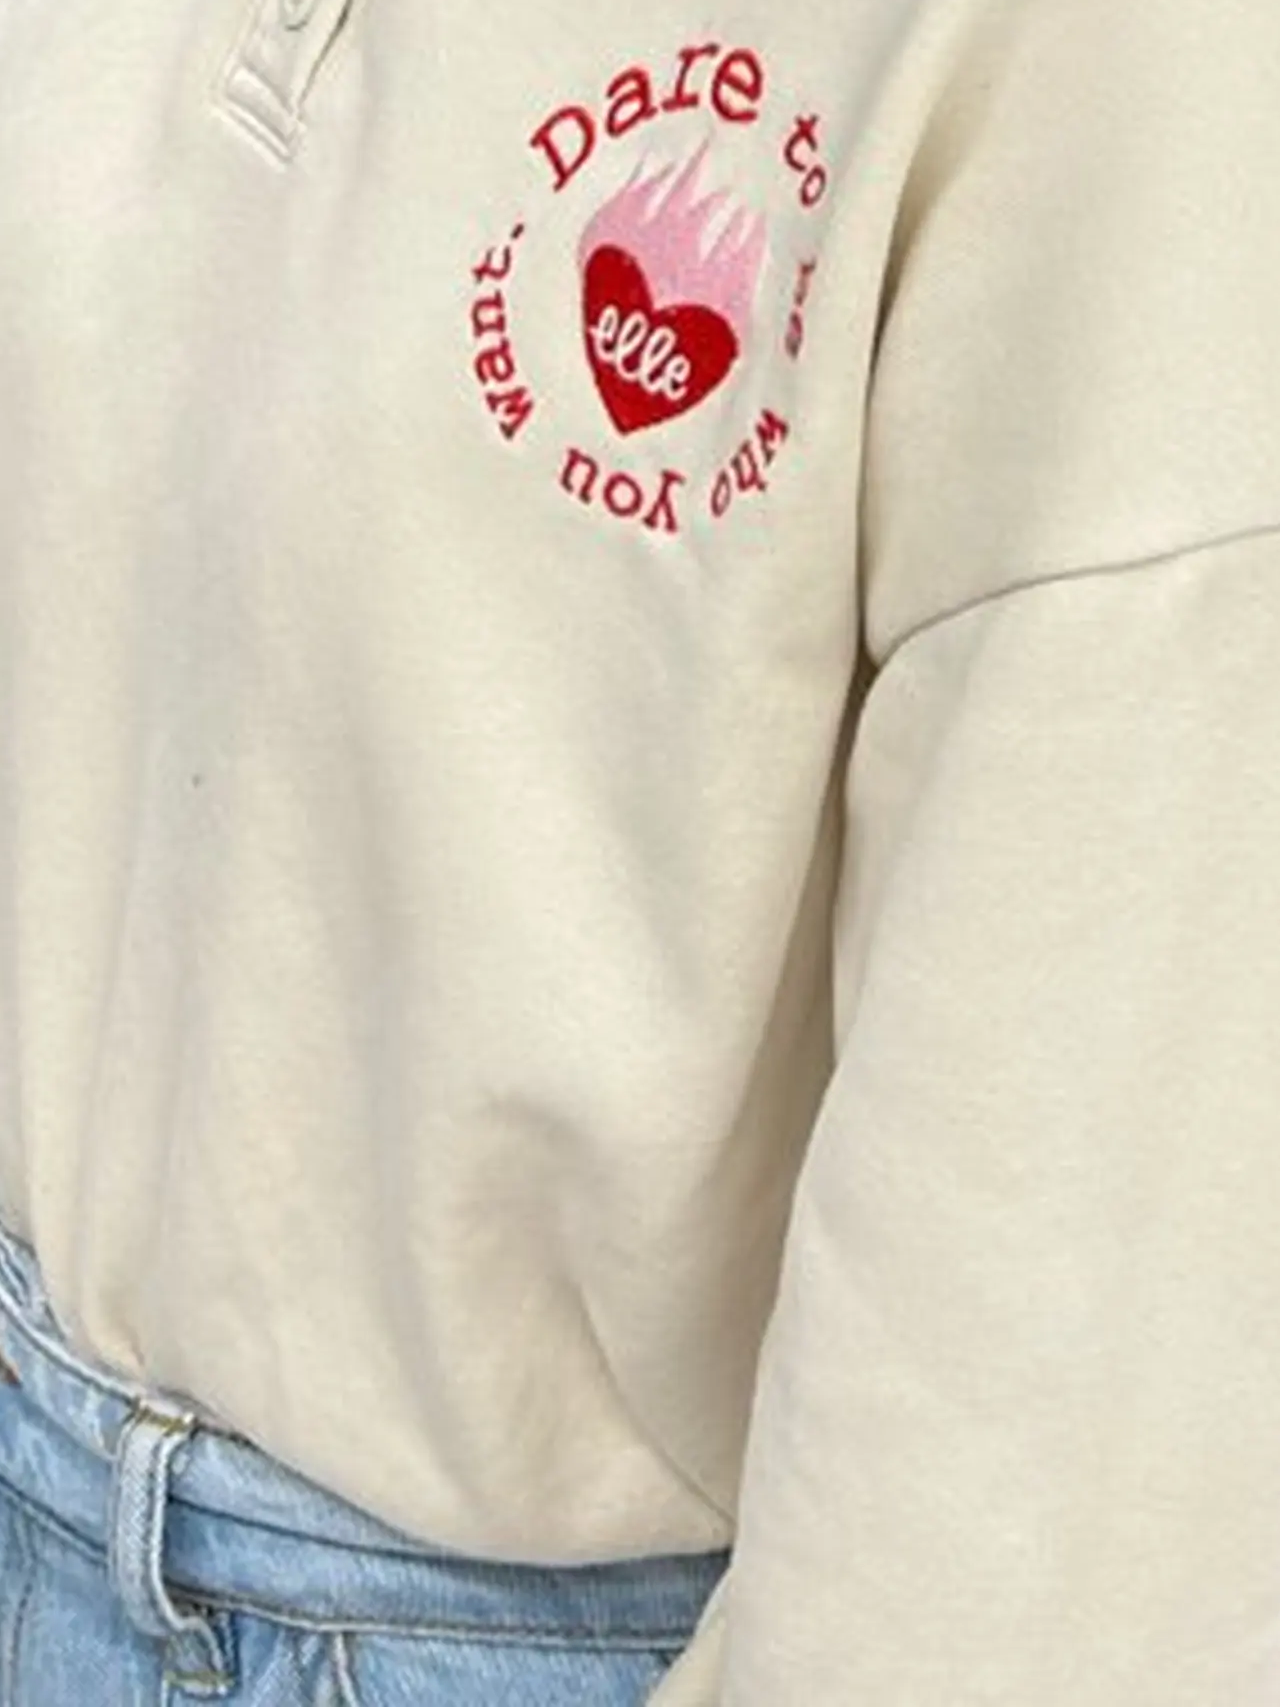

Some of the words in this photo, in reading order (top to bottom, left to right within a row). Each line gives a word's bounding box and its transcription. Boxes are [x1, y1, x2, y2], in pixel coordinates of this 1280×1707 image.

[529, 43, 765, 192] Dare
[781, 115, 827, 210] to
[587, 304, 693, 402] elle
[558, 446, 686, 534] you
[709, 407, 789, 519] who
